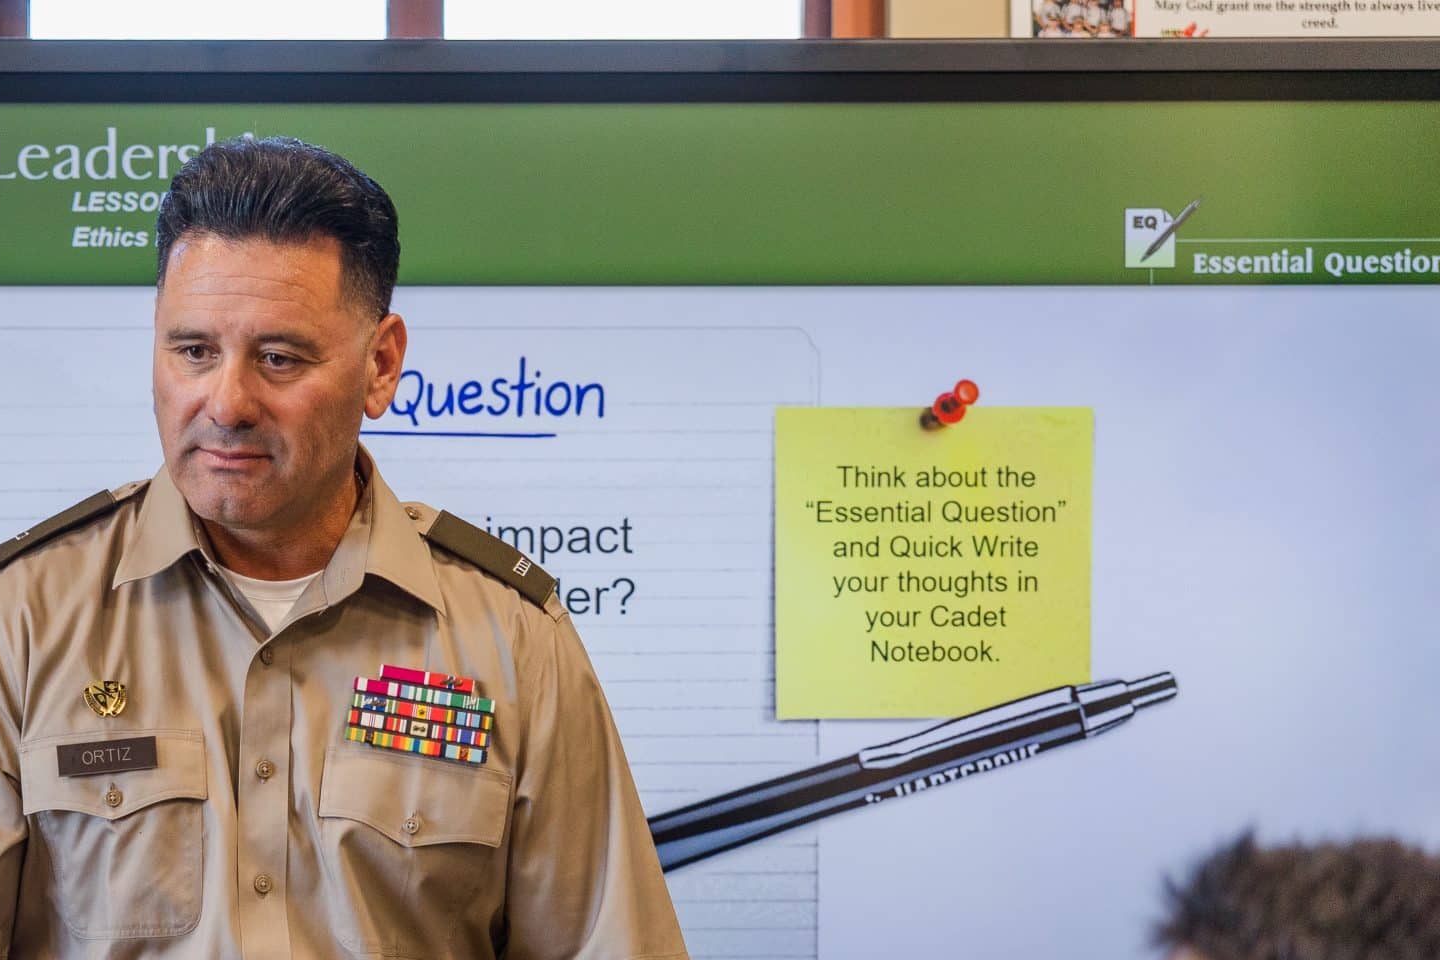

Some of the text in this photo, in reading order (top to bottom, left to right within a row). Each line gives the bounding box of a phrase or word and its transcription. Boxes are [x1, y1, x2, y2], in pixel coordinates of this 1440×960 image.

[1155, 0, 1182, 14] May
[1186, 0, 1213, 11] God
[1217, 1, 1249, 15] grant
[1253, 3, 1273, 12] me
[1276, 0, 1296, 12] the
[1300, 0, 1351, 14] strength
[1355, 1, 1367, 12] to
[1371, 0, 1414, 15] always
[1302, 17, 1338, 29] creed.
[72, 191, 167, 212] LESSO
[1133, 216, 1158, 230] EQ
[72, 226, 148, 247] Ethics
[1194, 248, 1313, 274] Essential
[391, 356, 606, 426] Question
[836, 465, 1036, 488] Think about the
[806, 500, 1067, 524] “Essential Question”
[833, 536, 1039, 559] and Quick Write
[833, 570, 1039, 599] your thoughts in
[865, 605, 1007, 633] your Cadet
[871, 640, 1001, 663] Notebook.
[81, 747, 132, 766] ORTIZ
